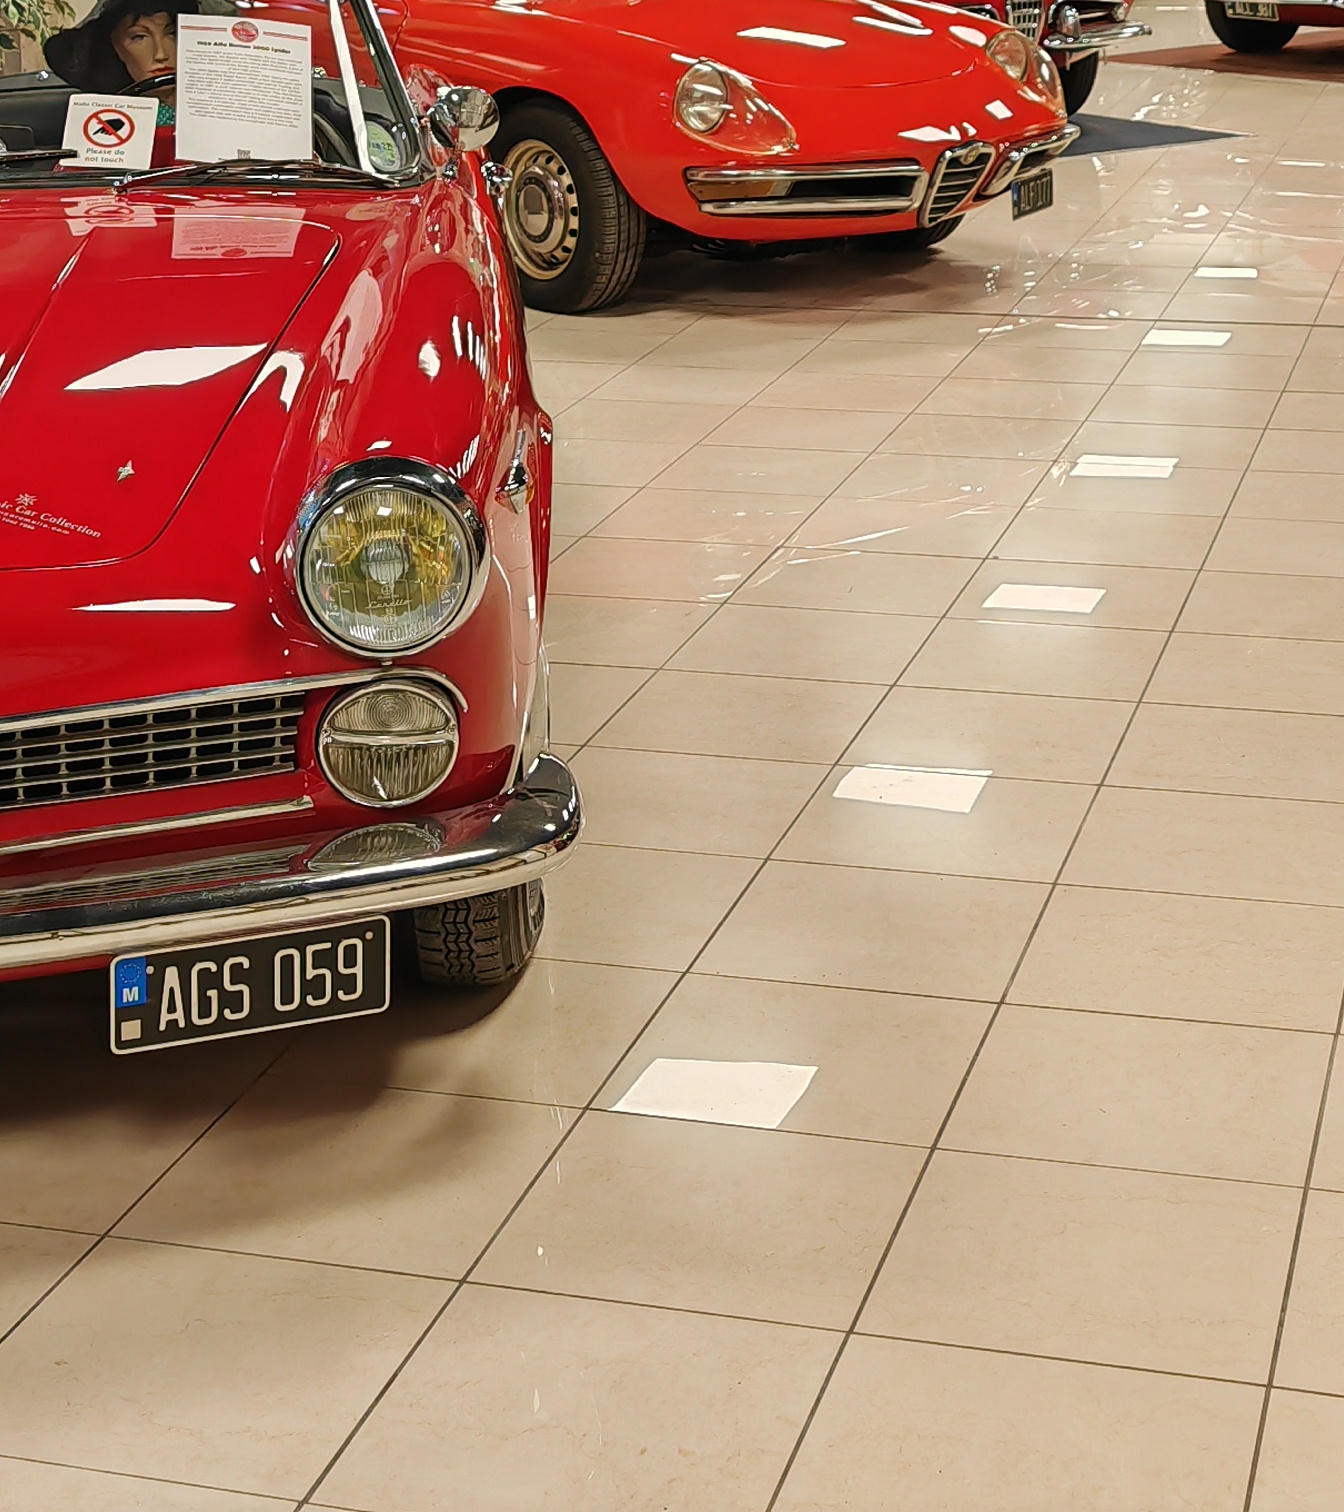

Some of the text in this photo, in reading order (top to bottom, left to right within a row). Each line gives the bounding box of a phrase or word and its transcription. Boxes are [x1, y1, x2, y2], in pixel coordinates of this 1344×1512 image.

[91, 101, 113, 109] Classic
[15, 503, 43, 518] Car
[39, 511, 102, 539] Collection
[121, 985, 139, 1004] M
[159, 937, 364, 1032] AGS 059
